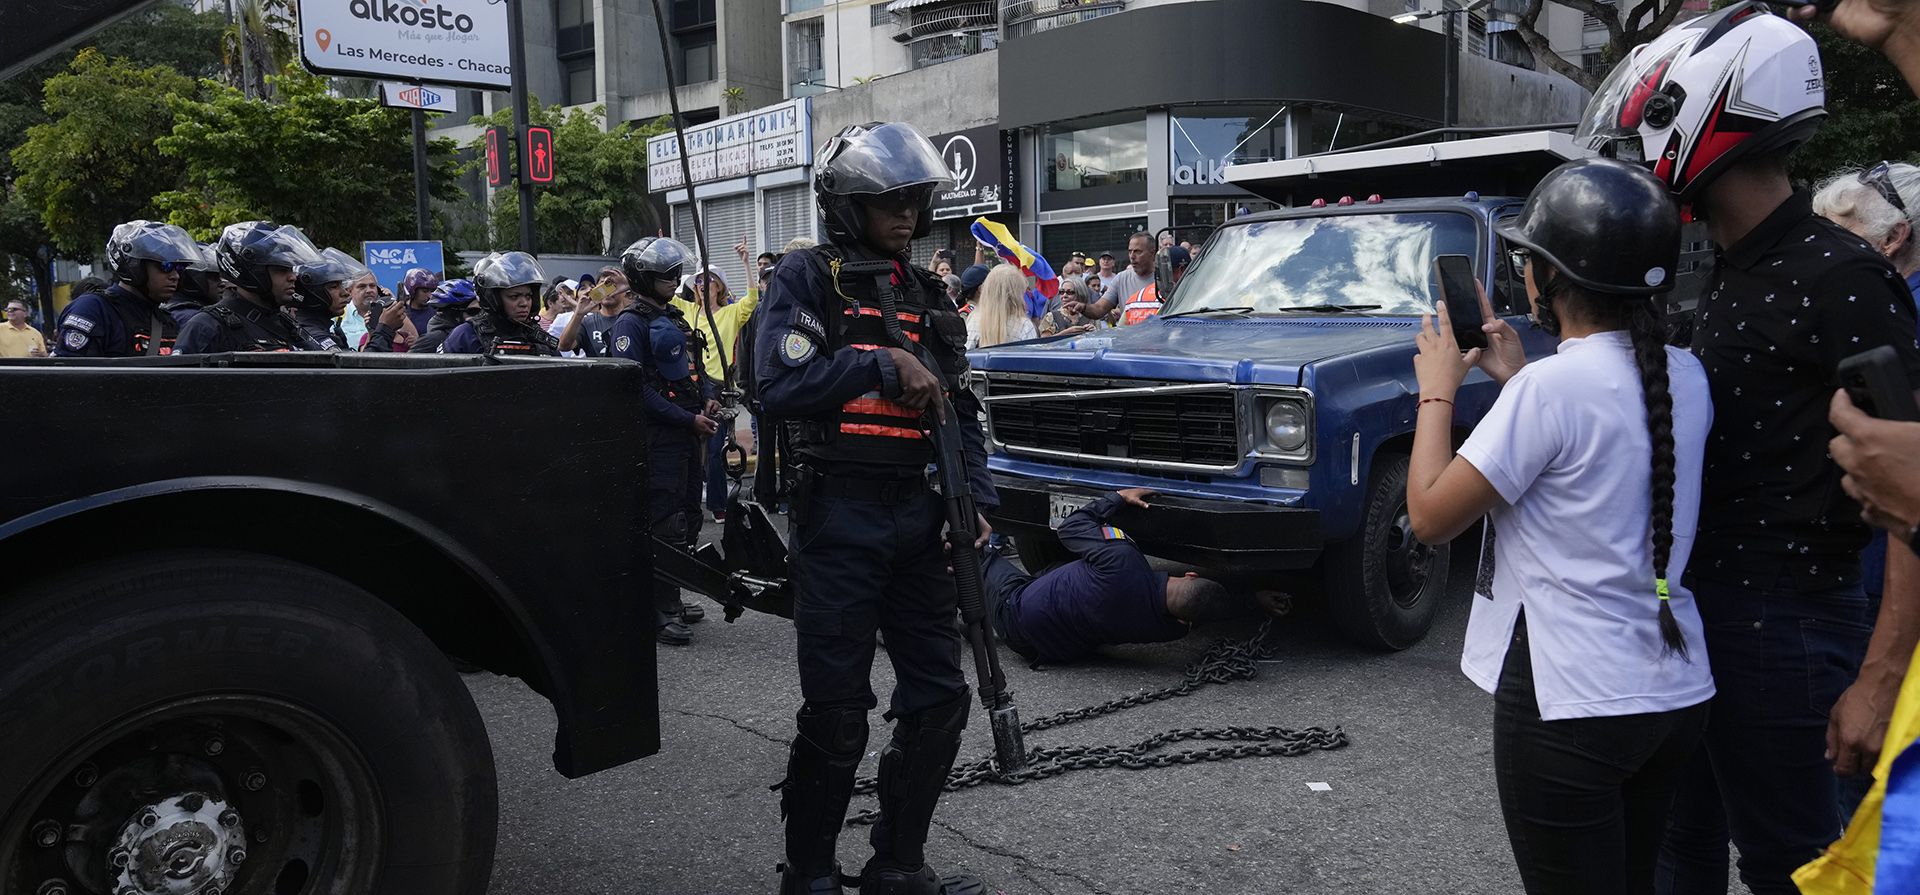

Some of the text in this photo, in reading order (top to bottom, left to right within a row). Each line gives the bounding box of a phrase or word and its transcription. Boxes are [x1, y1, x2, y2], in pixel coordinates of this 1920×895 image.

[350, 0, 474, 33] alkosto
[425, 34, 444, 44] que
[337, 43, 365, 59] Las
[369, 47, 445, 67] Mercedes
[457, 58, 511, 75] Chacao
[402, 87, 440, 106] VIARTE
[656, 111, 785, 158] ELETROMARCONI
[654, 149, 747, 177] PARTE ELECRICAS
[941, 190, 970, 200] MULTIMEDIA
[370, 248, 418, 265] MCA
